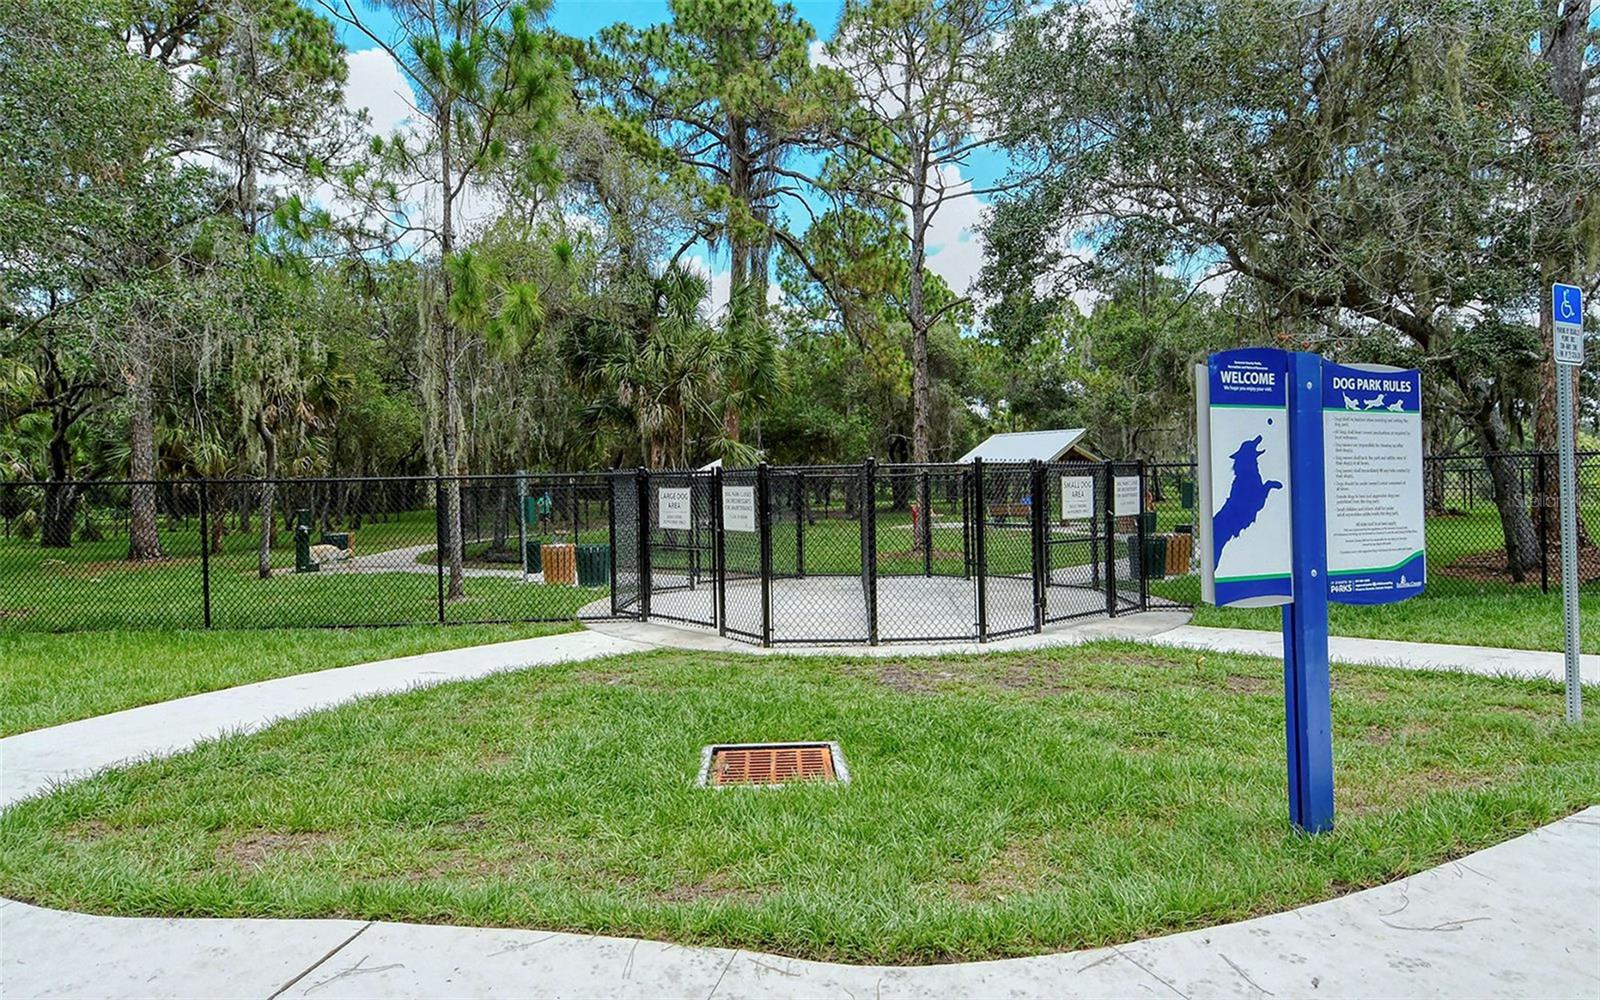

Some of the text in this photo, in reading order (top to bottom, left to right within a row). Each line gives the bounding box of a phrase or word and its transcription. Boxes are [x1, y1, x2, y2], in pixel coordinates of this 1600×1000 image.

[1220, 370, 1275, 386] WELCOME
[1333, 377, 1412, 393] DOG PARK RULES
[1063, 480, 1092, 489] SMALL DOG
[1071, 490, 1085, 498] AREA
[1330, 584, 1353, 593] PARKS
